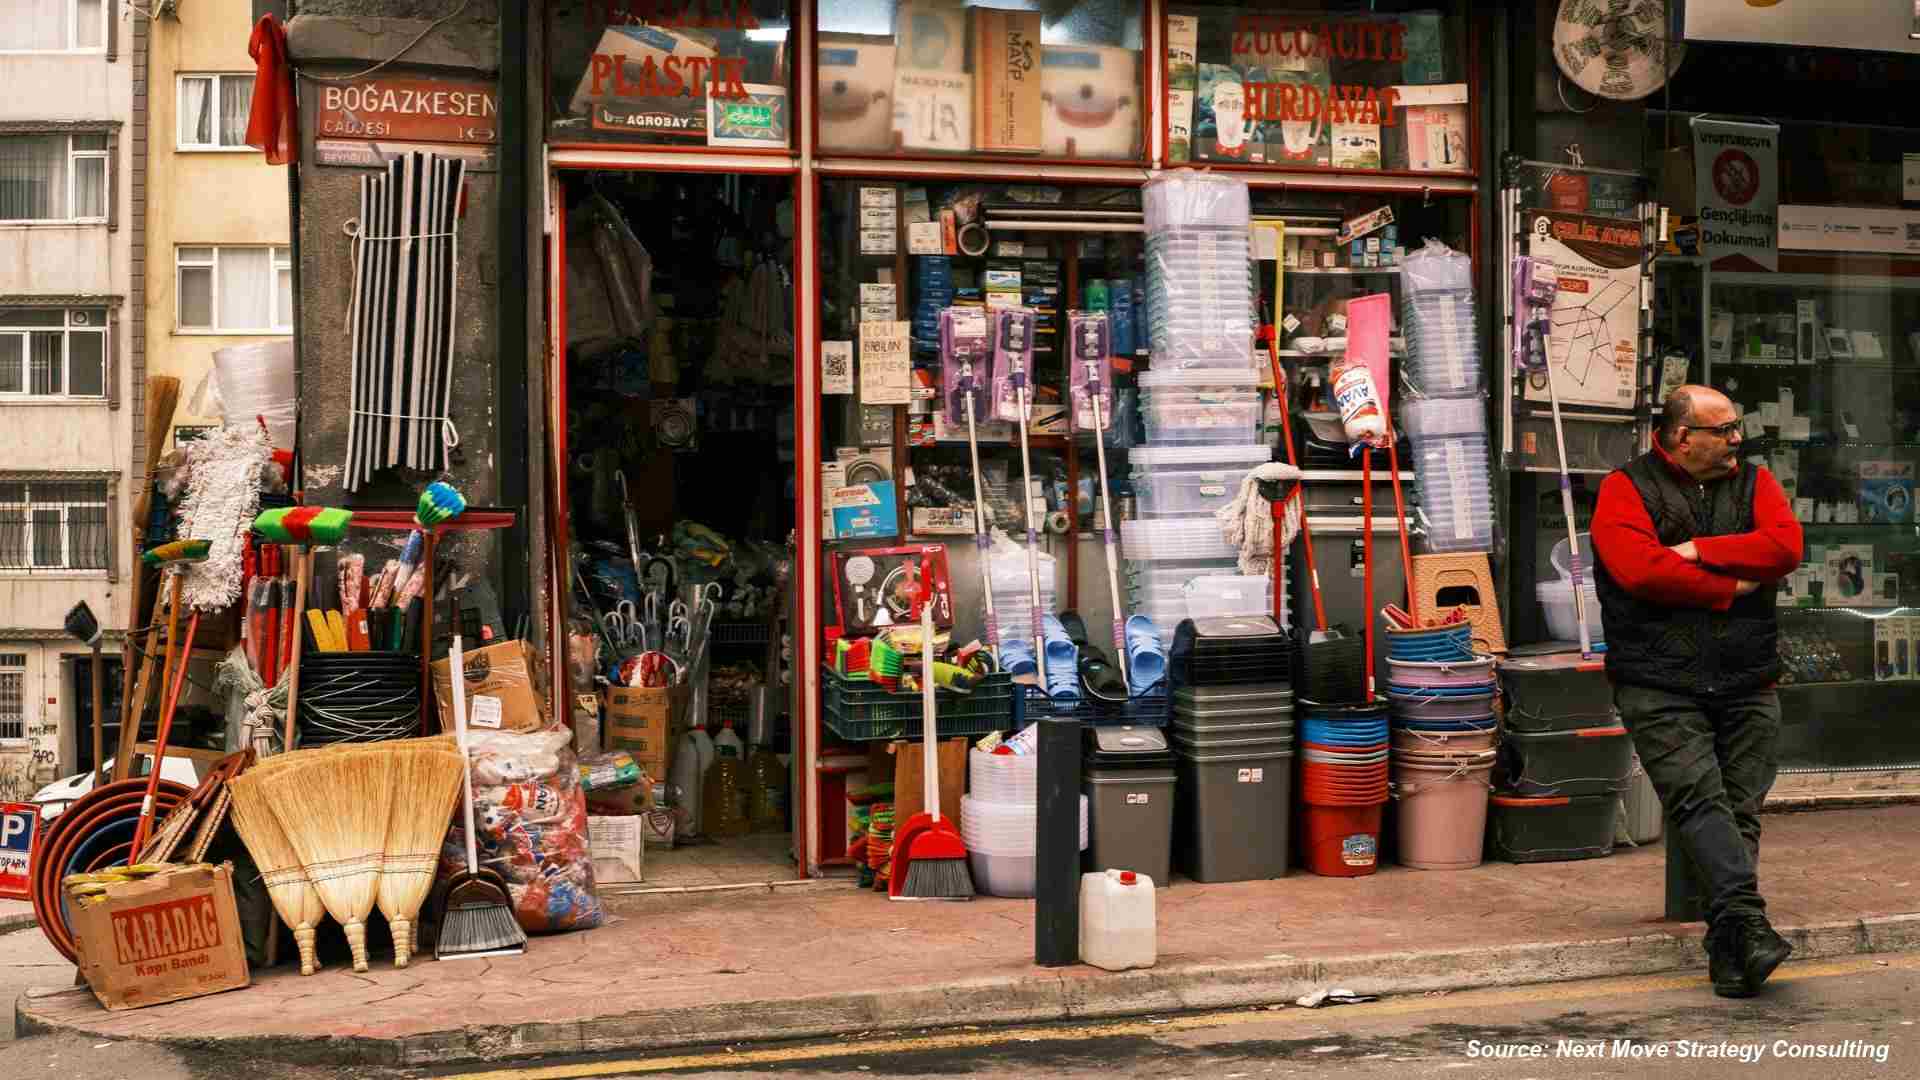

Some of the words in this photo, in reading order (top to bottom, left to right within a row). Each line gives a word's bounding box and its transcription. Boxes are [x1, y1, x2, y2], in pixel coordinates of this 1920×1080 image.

[326, 84, 498, 117] BOĞAZKESEN
[627, 114, 689, 129] AGROBAY
[1703, 231, 1770, 249] Dokunma!
[1, 815, 25, 846] P
[113, 896, 217, 964] KARADAĞ
